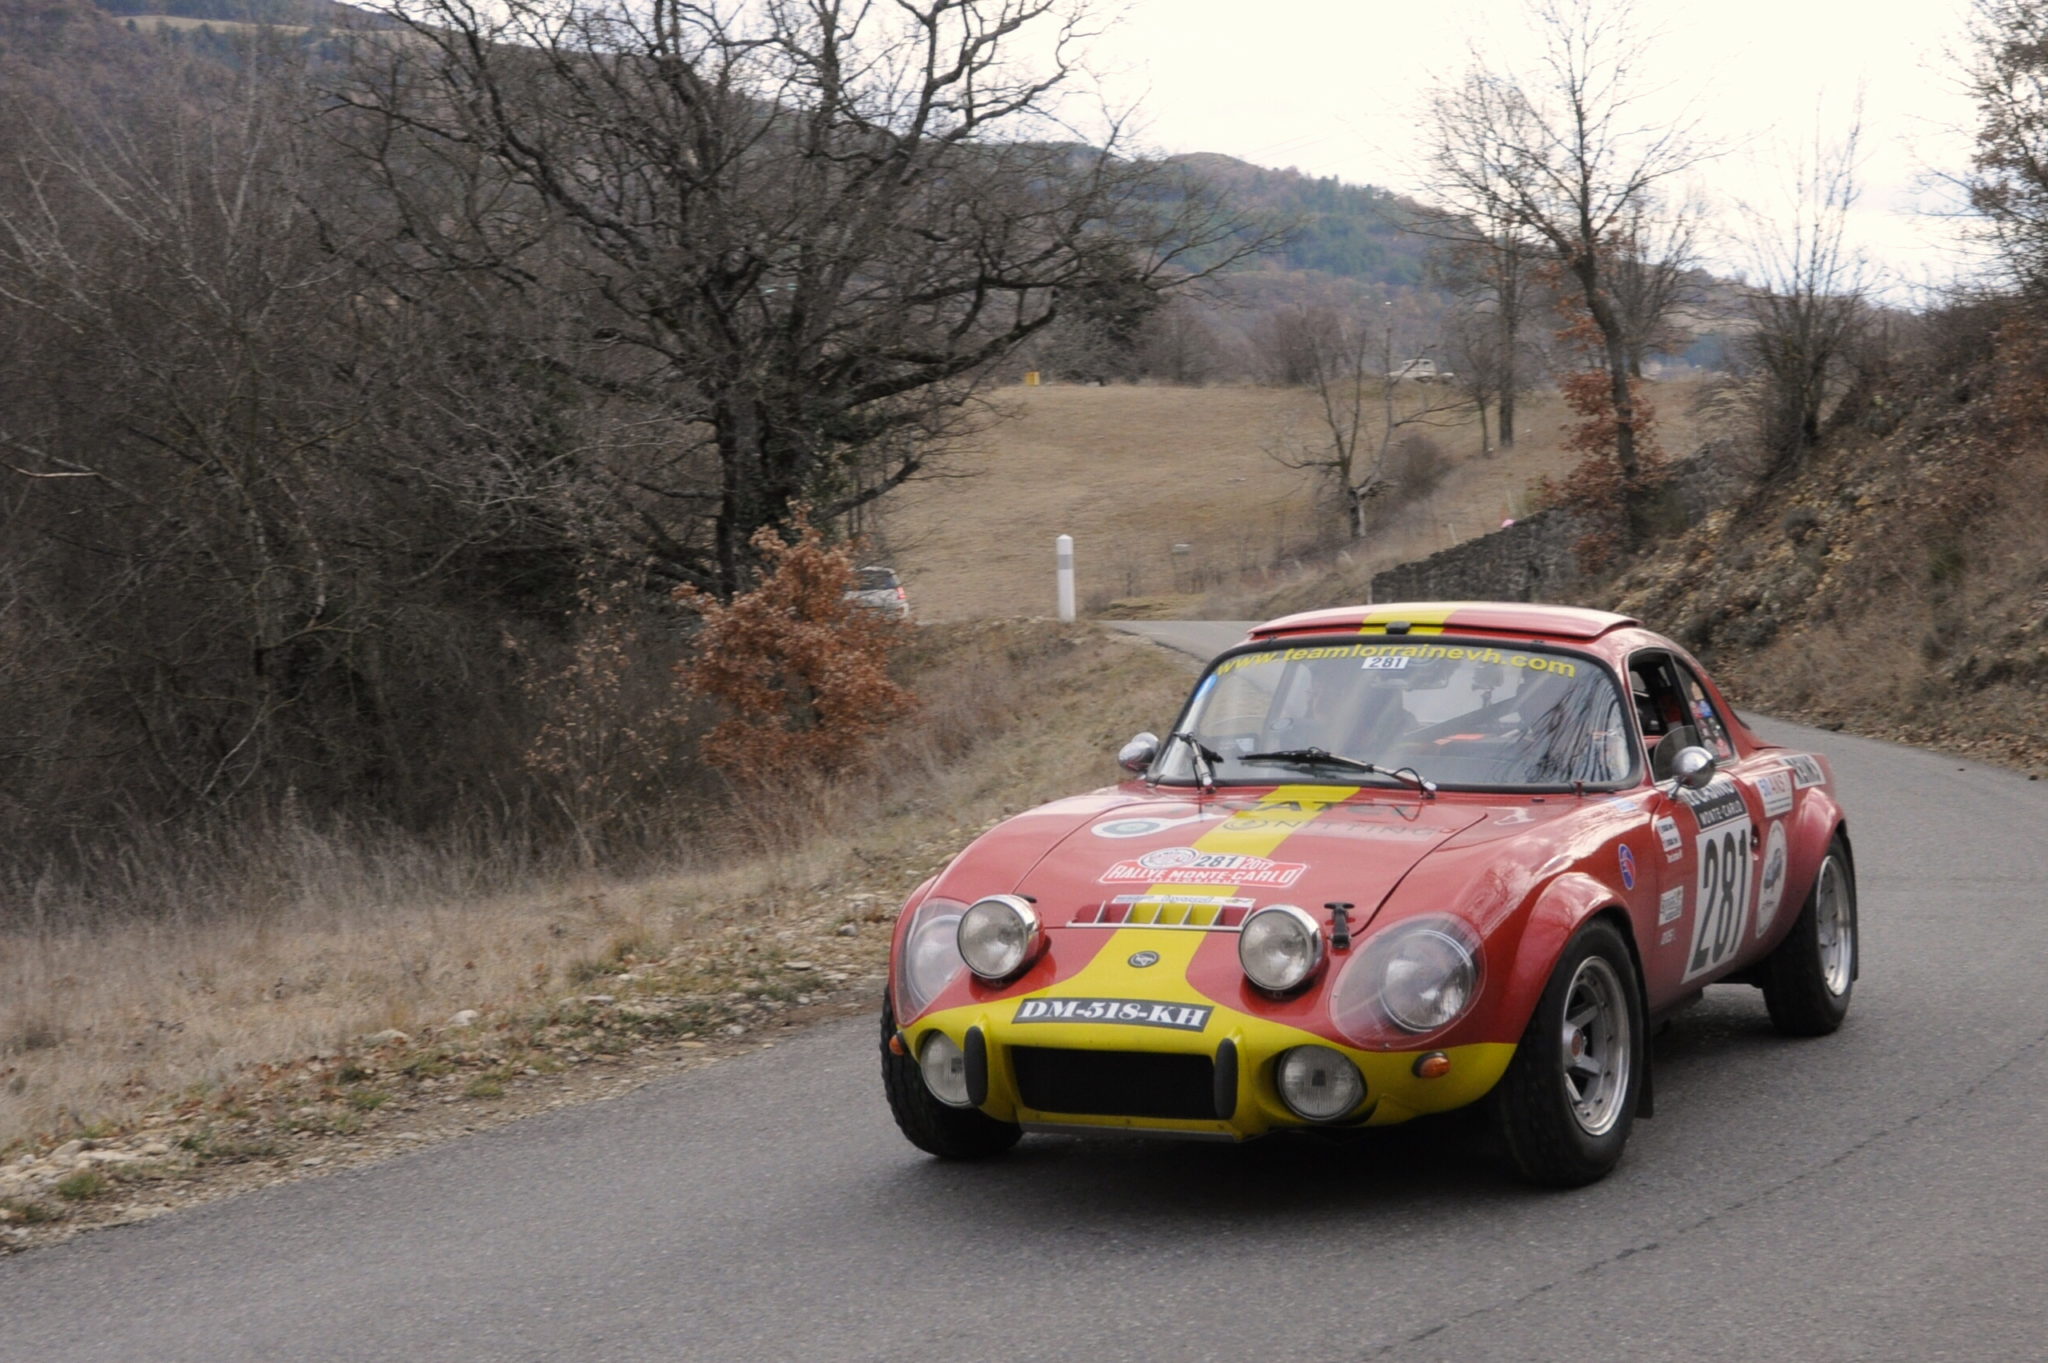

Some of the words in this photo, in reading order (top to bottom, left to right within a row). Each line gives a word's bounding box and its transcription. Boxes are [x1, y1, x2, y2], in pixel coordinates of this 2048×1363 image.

[1215, 644, 1576, 678] www.teamlorrainevh.com
[1369, 657, 1402, 669] 281
[1107, 864, 1166, 880] RALLYE
[1169, 868, 1300, 885] MONTE-CARLO
[1194, 855, 1237, 868] 281
[1240, 857, 1271, 870] 2017
[1689, 828, 1747, 973] 281
[1017, 1000, 1207, 1027] DM-518-KH
